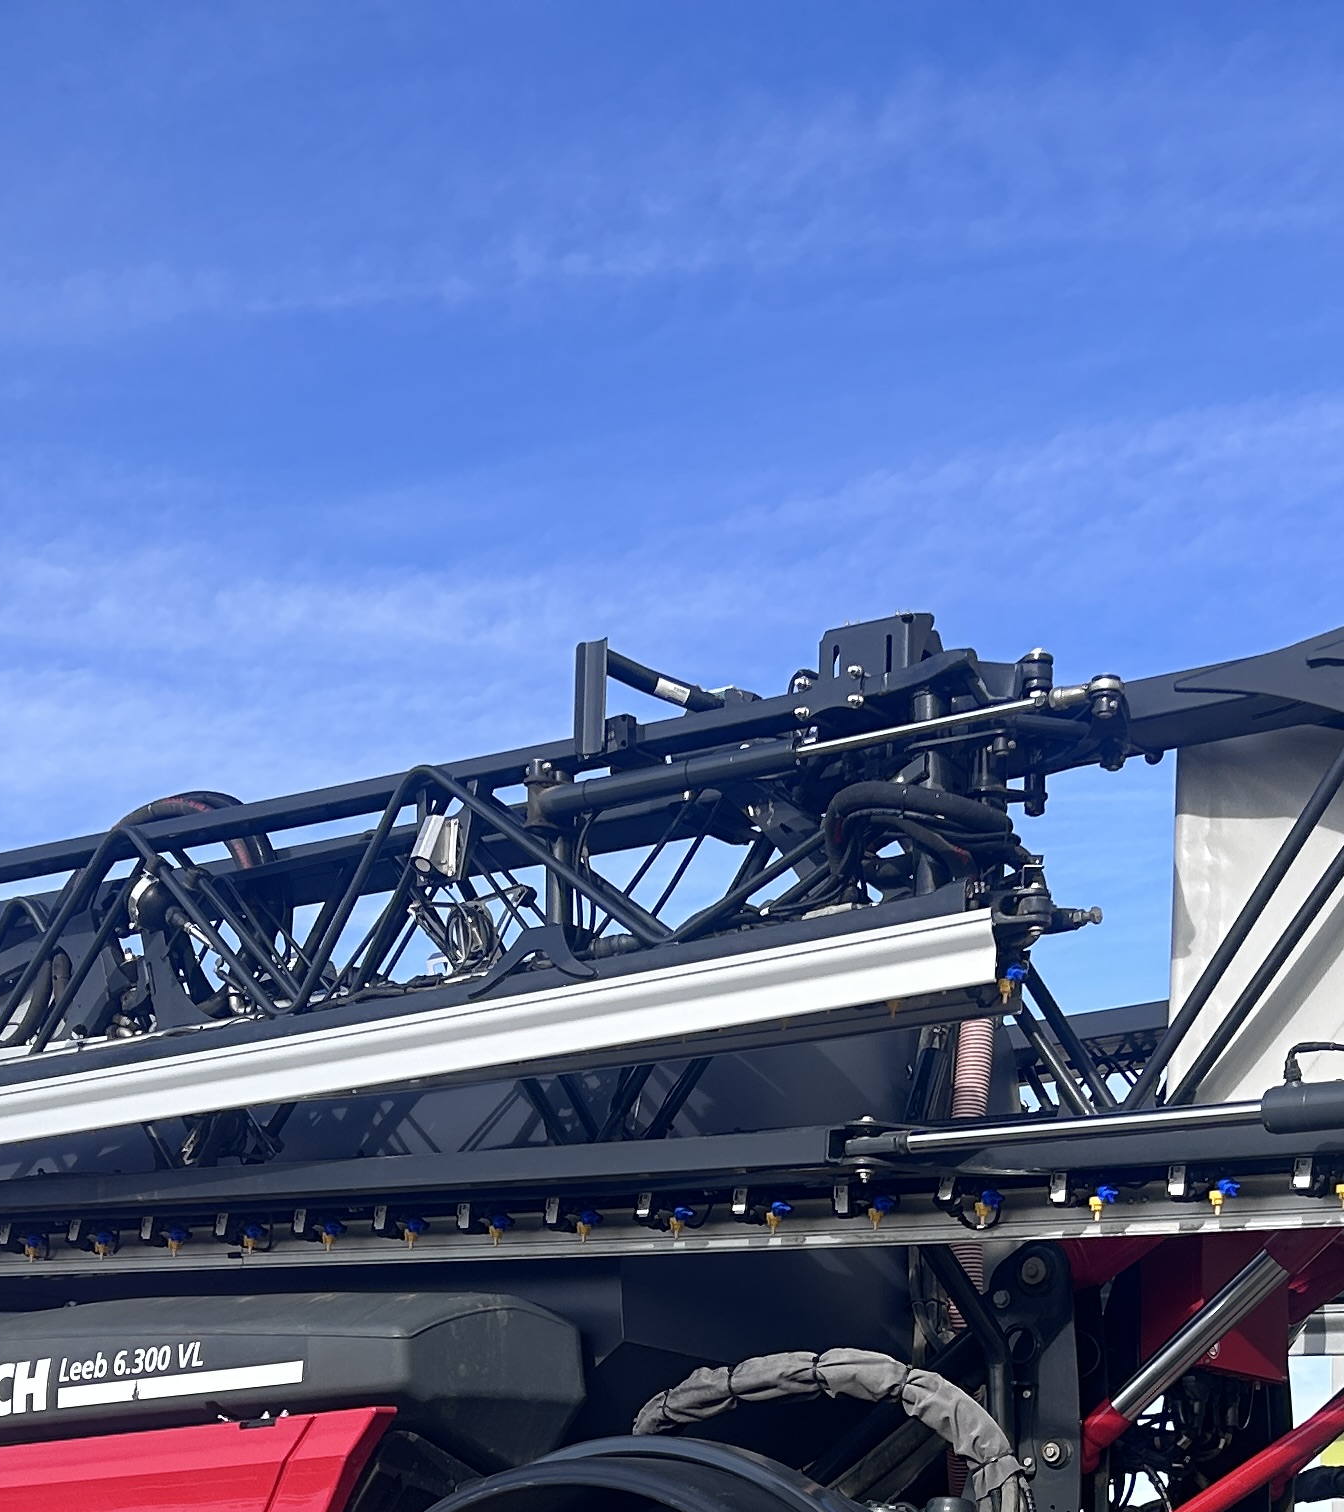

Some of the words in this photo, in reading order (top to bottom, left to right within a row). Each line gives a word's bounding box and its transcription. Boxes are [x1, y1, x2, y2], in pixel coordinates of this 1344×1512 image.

[58, 1352, 107, 1382] Leeb
[113, 1346, 171, 1376] 6.300
[177, 1341, 204, 1368] VL
